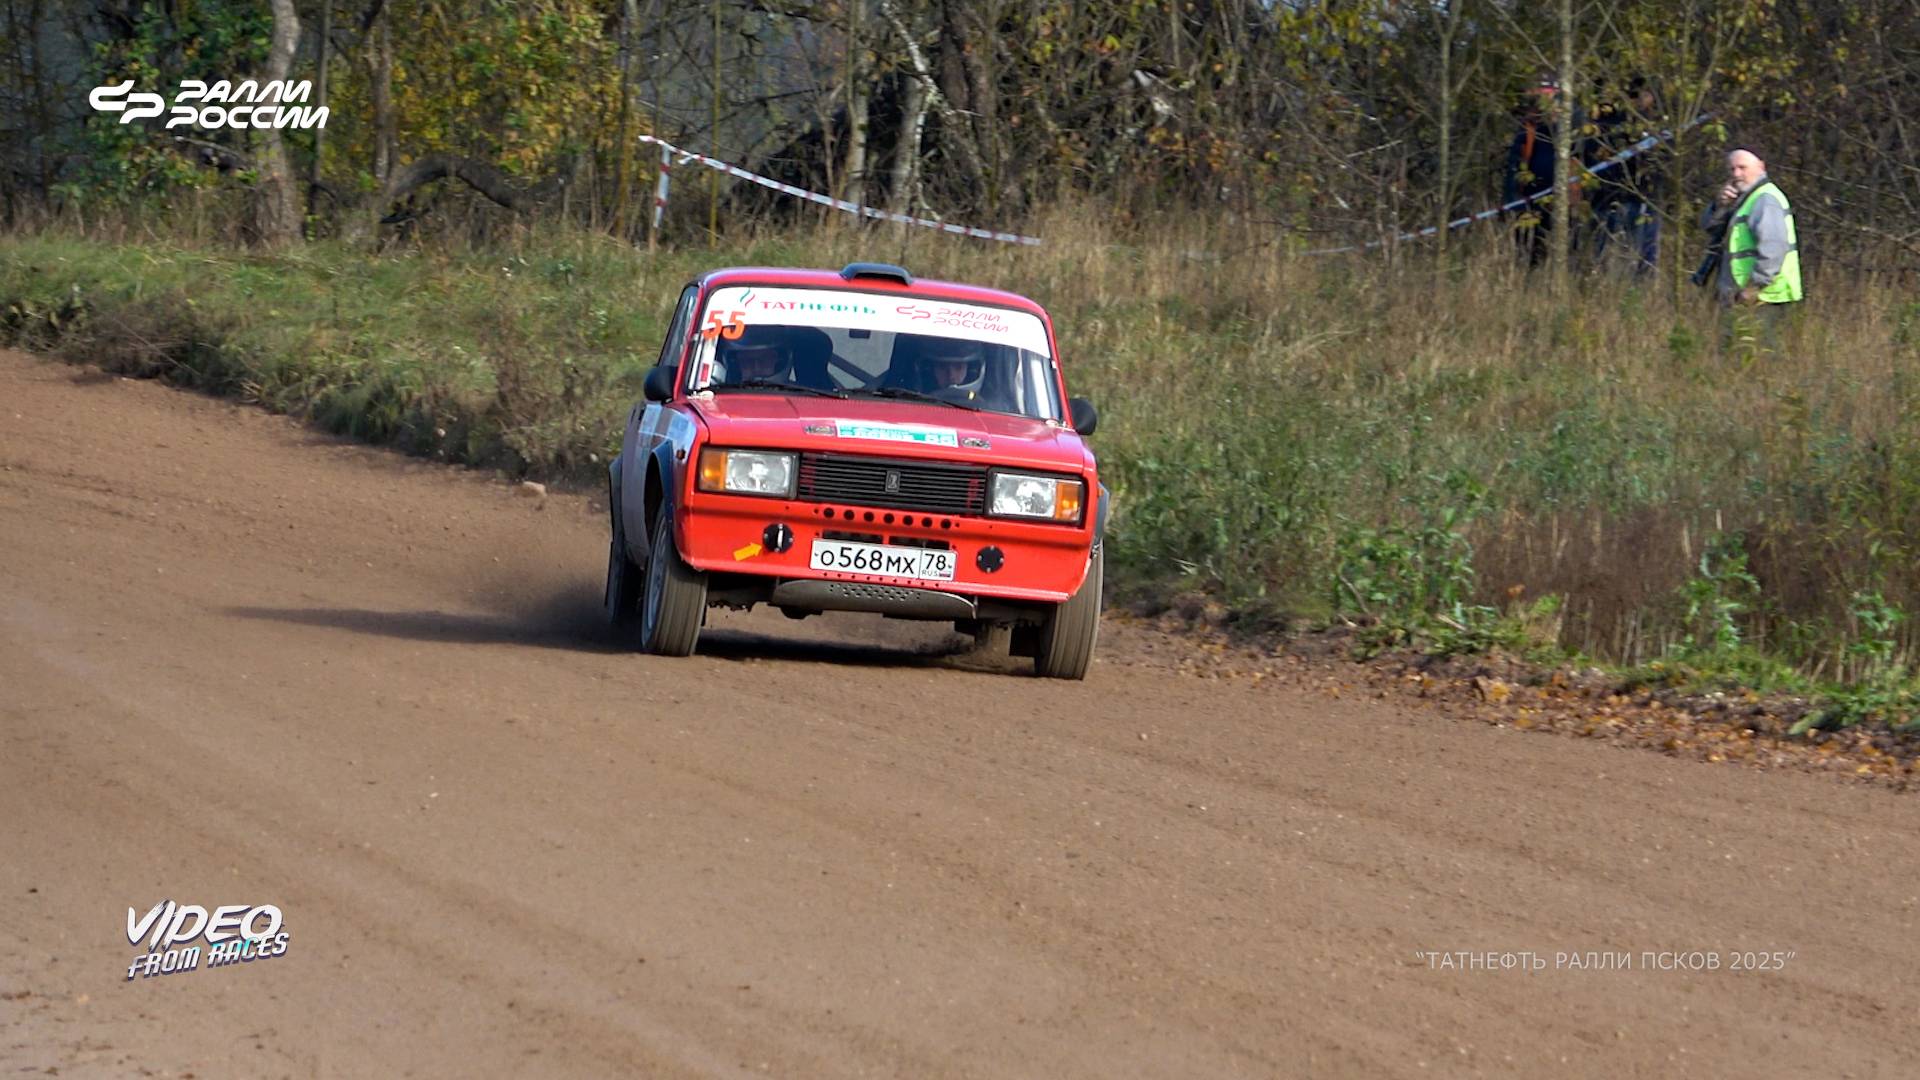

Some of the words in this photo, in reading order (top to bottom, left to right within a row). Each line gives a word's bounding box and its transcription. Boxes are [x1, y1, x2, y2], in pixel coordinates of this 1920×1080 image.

[760, 300, 876, 315] ТАТНЕФТЬ
[936, 307, 1001, 321] РАЛЛИ
[700, 310, 746, 340] 55
[933, 319, 1009, 334] РОССИИ
[925, 553, 947, 571] 78
